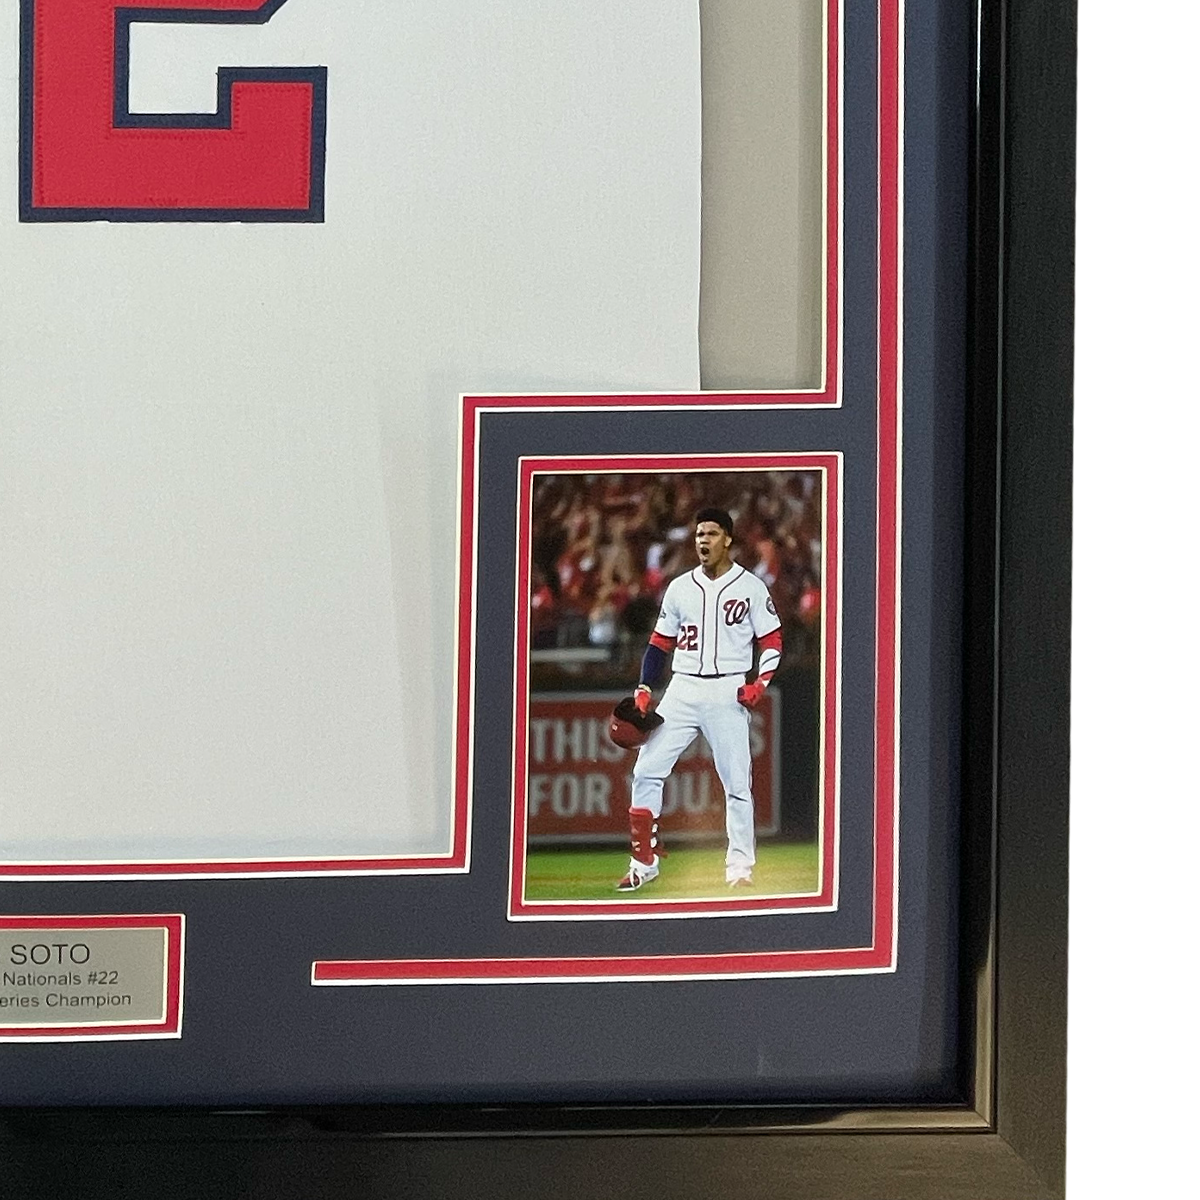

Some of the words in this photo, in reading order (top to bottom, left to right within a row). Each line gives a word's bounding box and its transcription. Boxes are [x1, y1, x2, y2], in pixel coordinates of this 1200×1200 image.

[530, 773, 611, 817] FOR
[9, 943, 91, 965] SOTO
[3, 971, 82, 987] Nationals
[87, 970, 119, 985] #22
[45, 991, 133, 1010] Champion
